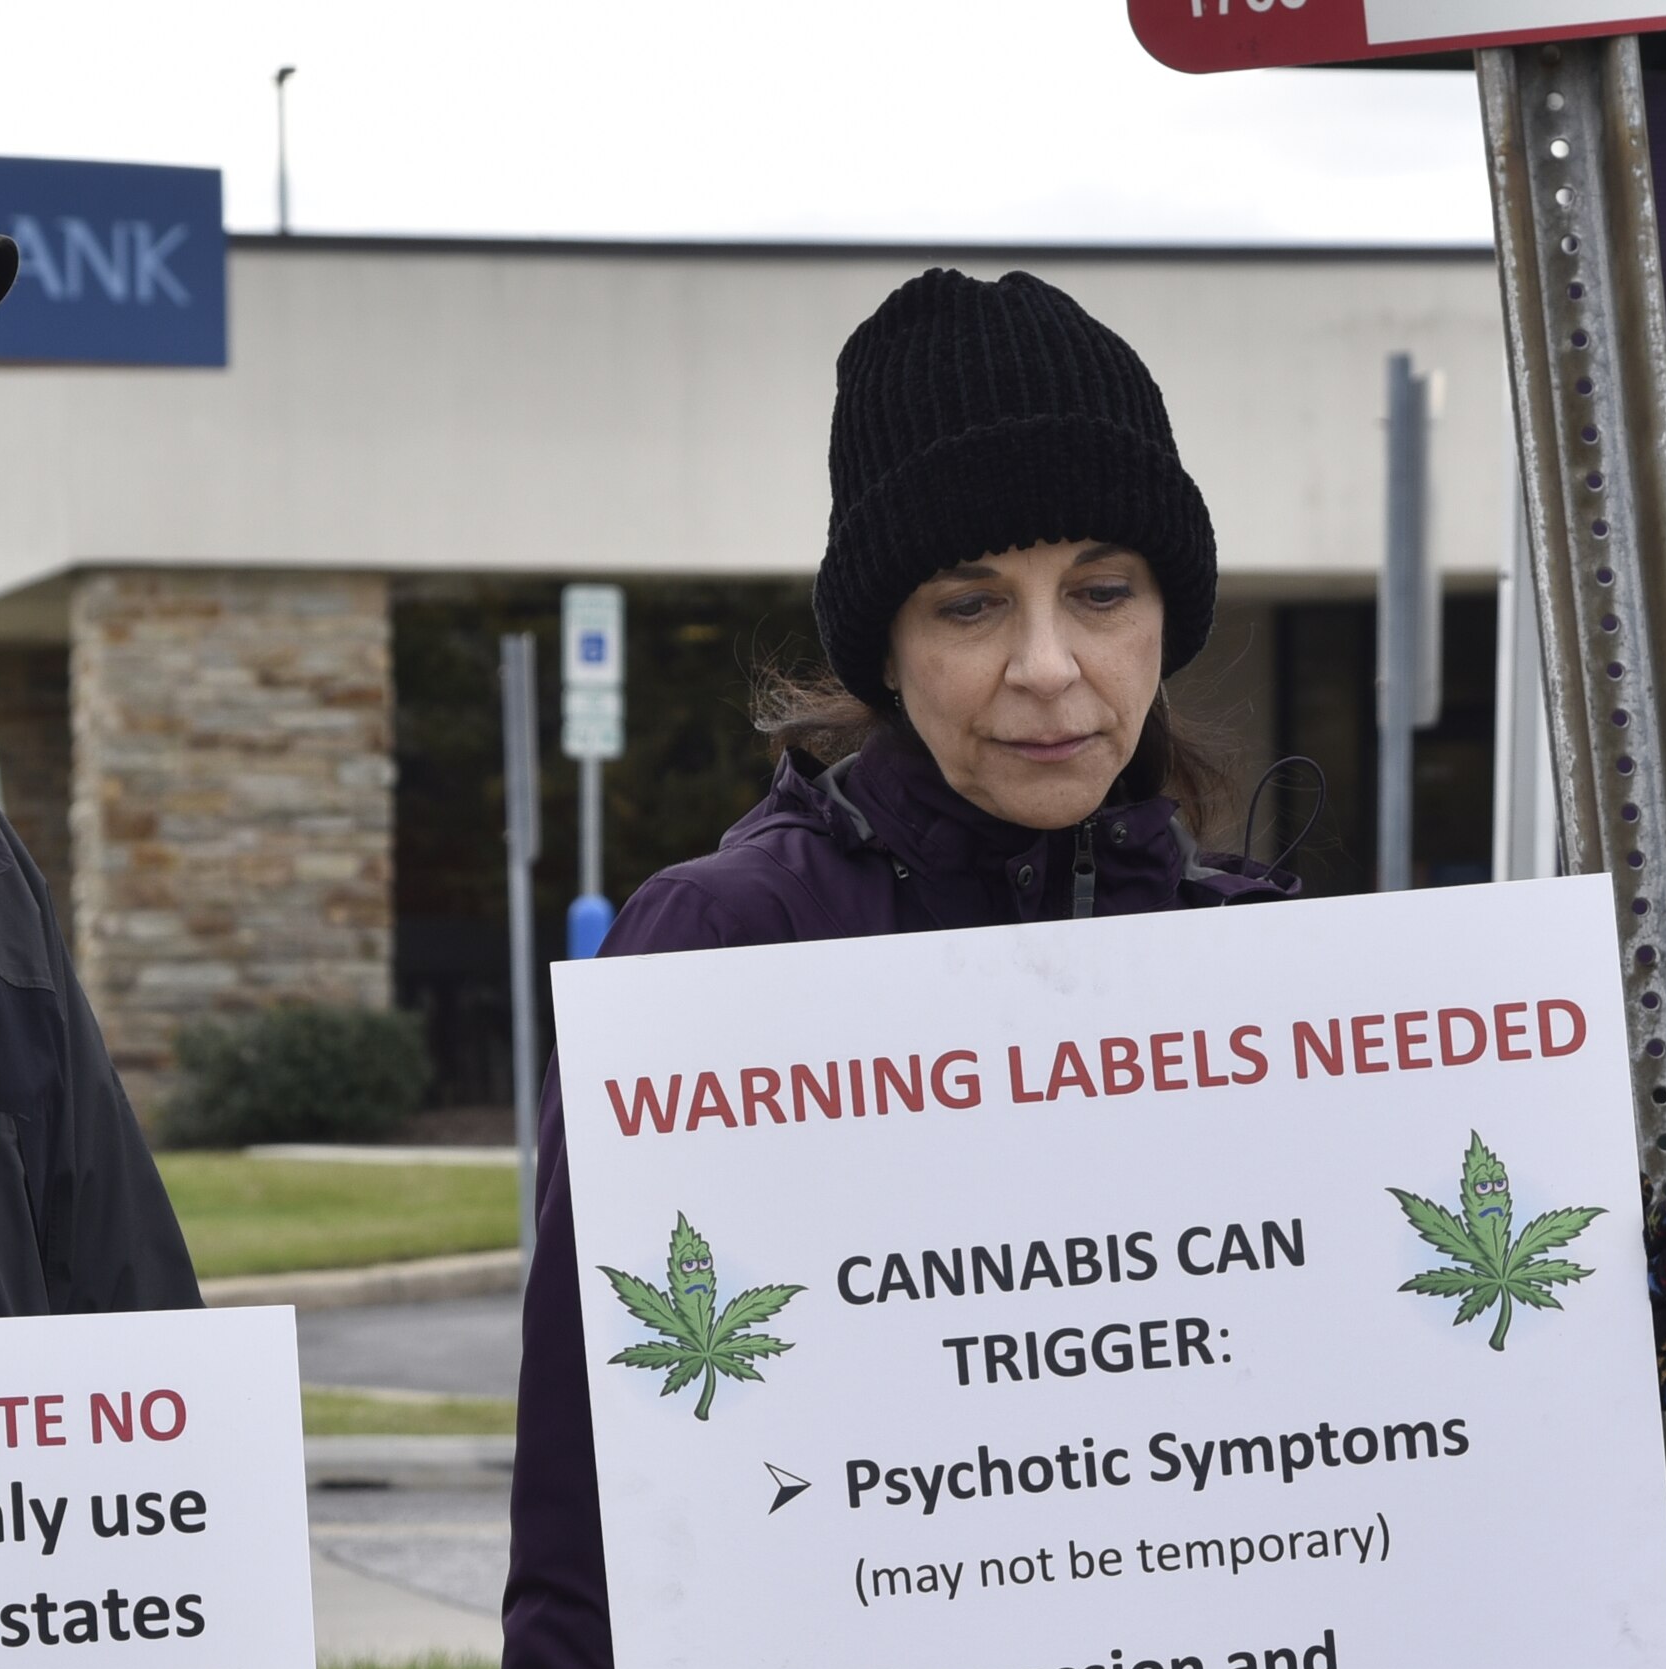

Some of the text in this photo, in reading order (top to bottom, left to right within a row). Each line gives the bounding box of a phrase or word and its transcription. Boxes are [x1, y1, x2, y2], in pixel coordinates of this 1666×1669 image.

[604, 999, 1587, 1137] WARNING LABELS NEEDED
[837, 1218, 1305, 1306] CANNABIS CAN
[941, 1317, 1232, 1386] TRIGGER:
[90, 1389, 187, 1444] NO
[845, 1418, 1470, 1516] Psychotic Symptoms
[90, 1489, 207, 1539] use
[855, 1512, 1390, 1608] (may not be temporary)
[0, 1588, 206, 1648] states
